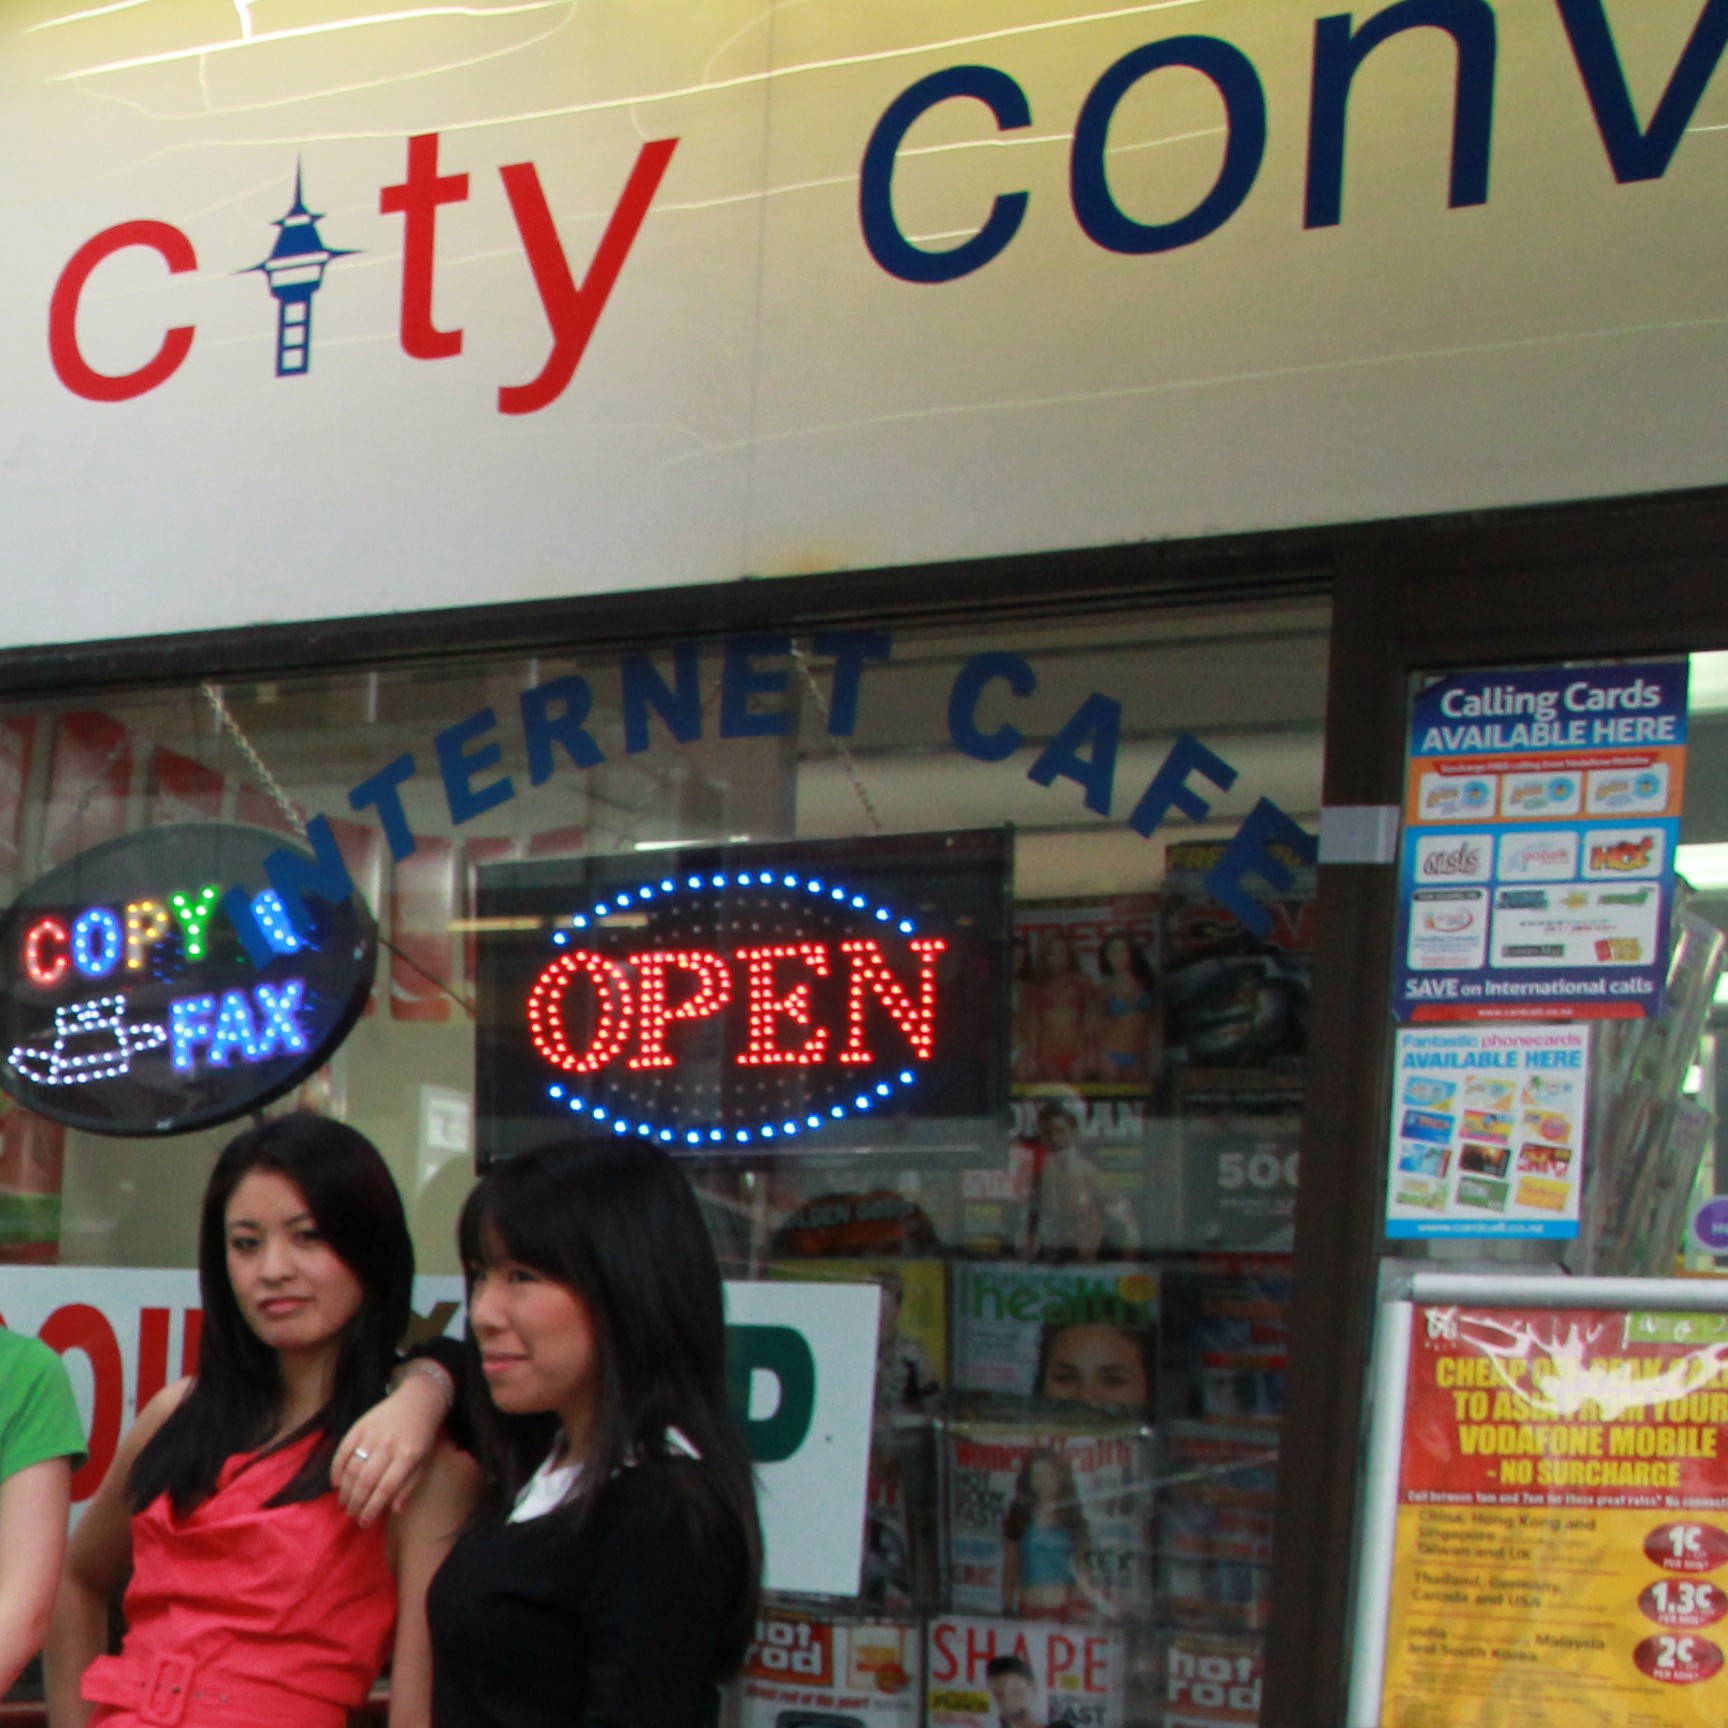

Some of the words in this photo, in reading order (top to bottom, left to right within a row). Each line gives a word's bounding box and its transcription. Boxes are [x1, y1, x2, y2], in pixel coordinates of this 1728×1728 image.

[1440, 685, 1560, 721] Calling
[1563, 679, 1662, 712] Cards
[1420, 721, 1587, 752] AVAILABLE
[1592, 715, 1677, 743] HERE
[225, 629, 893, 969] INTERNET
[946, 649, 1321, 934] CAFE
[25, 884, 221, 990] COPY
[1404, 977, 1460, 999] SAVE
[1460, 983, 1482, 997] on
[1484, 979, 1607, 997] International
[1608, 976, 1655, 995] calls
[526, 937, 948, 1075] OPEN
[168, 978, 310, 1072] FAX
[1480, 1033, 1582, 1049] phonecards
[1402, 1051, 1518, 1069] AVAILABLE
[1524, 1050, 1582, 1068] HERE
[1435, 1356, 1528, 1389] CHEAP
[1452, 1390, 1489, 1421] TO
[1458, 1424, 1604, 1456] VODAFONE
[1609, 1426, 1718, 1457] MOBILE
[1500, 1460, 1535, 1485] NO
[1537, 1461, 1681, 1488] SURCHARGE
[1519, 1513, 1562, 1532] Kong
[931, 1623, 1109, 1693] SHAPE
[1167, 1648, 1255, 1683] hot
[1167, 1676, 1263, 1712] rod
